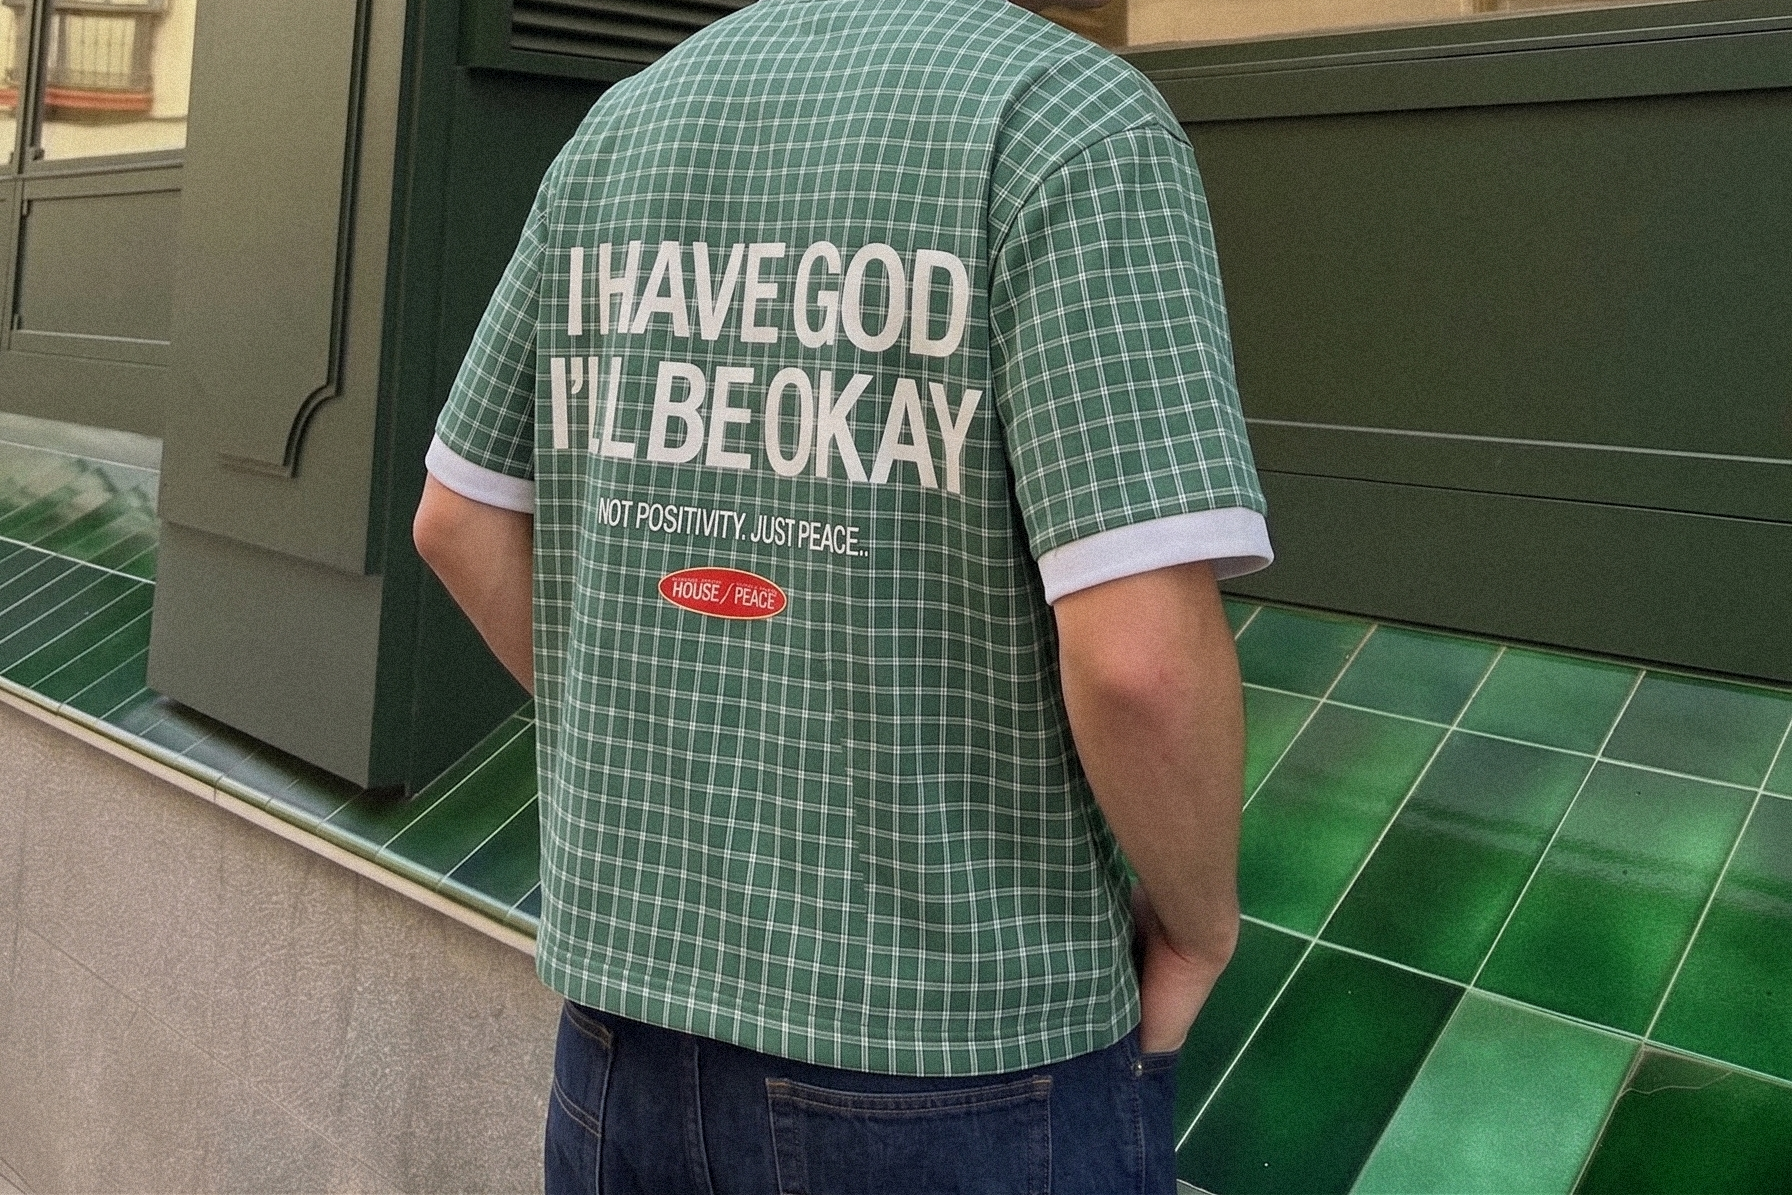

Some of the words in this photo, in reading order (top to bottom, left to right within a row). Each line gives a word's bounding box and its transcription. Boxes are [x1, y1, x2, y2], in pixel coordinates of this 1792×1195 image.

[567, 246, 584, 336] I
[599, 240, 787, 343] HAVE
[793, 240, 969, 357] GOD
[550, 356, 636, 460] I'LL
[646, 361, 755, 470] BE
[764, 366, 984, 495] OKAY
[598, 497, 633, 527] NOT
[635, 502, 746, 541] POSITIVITY.
[750, 514, 796, 547] JUST
[672, 581, 720, 602] HOUSE
[734, 586, 777, 610] PEACE
